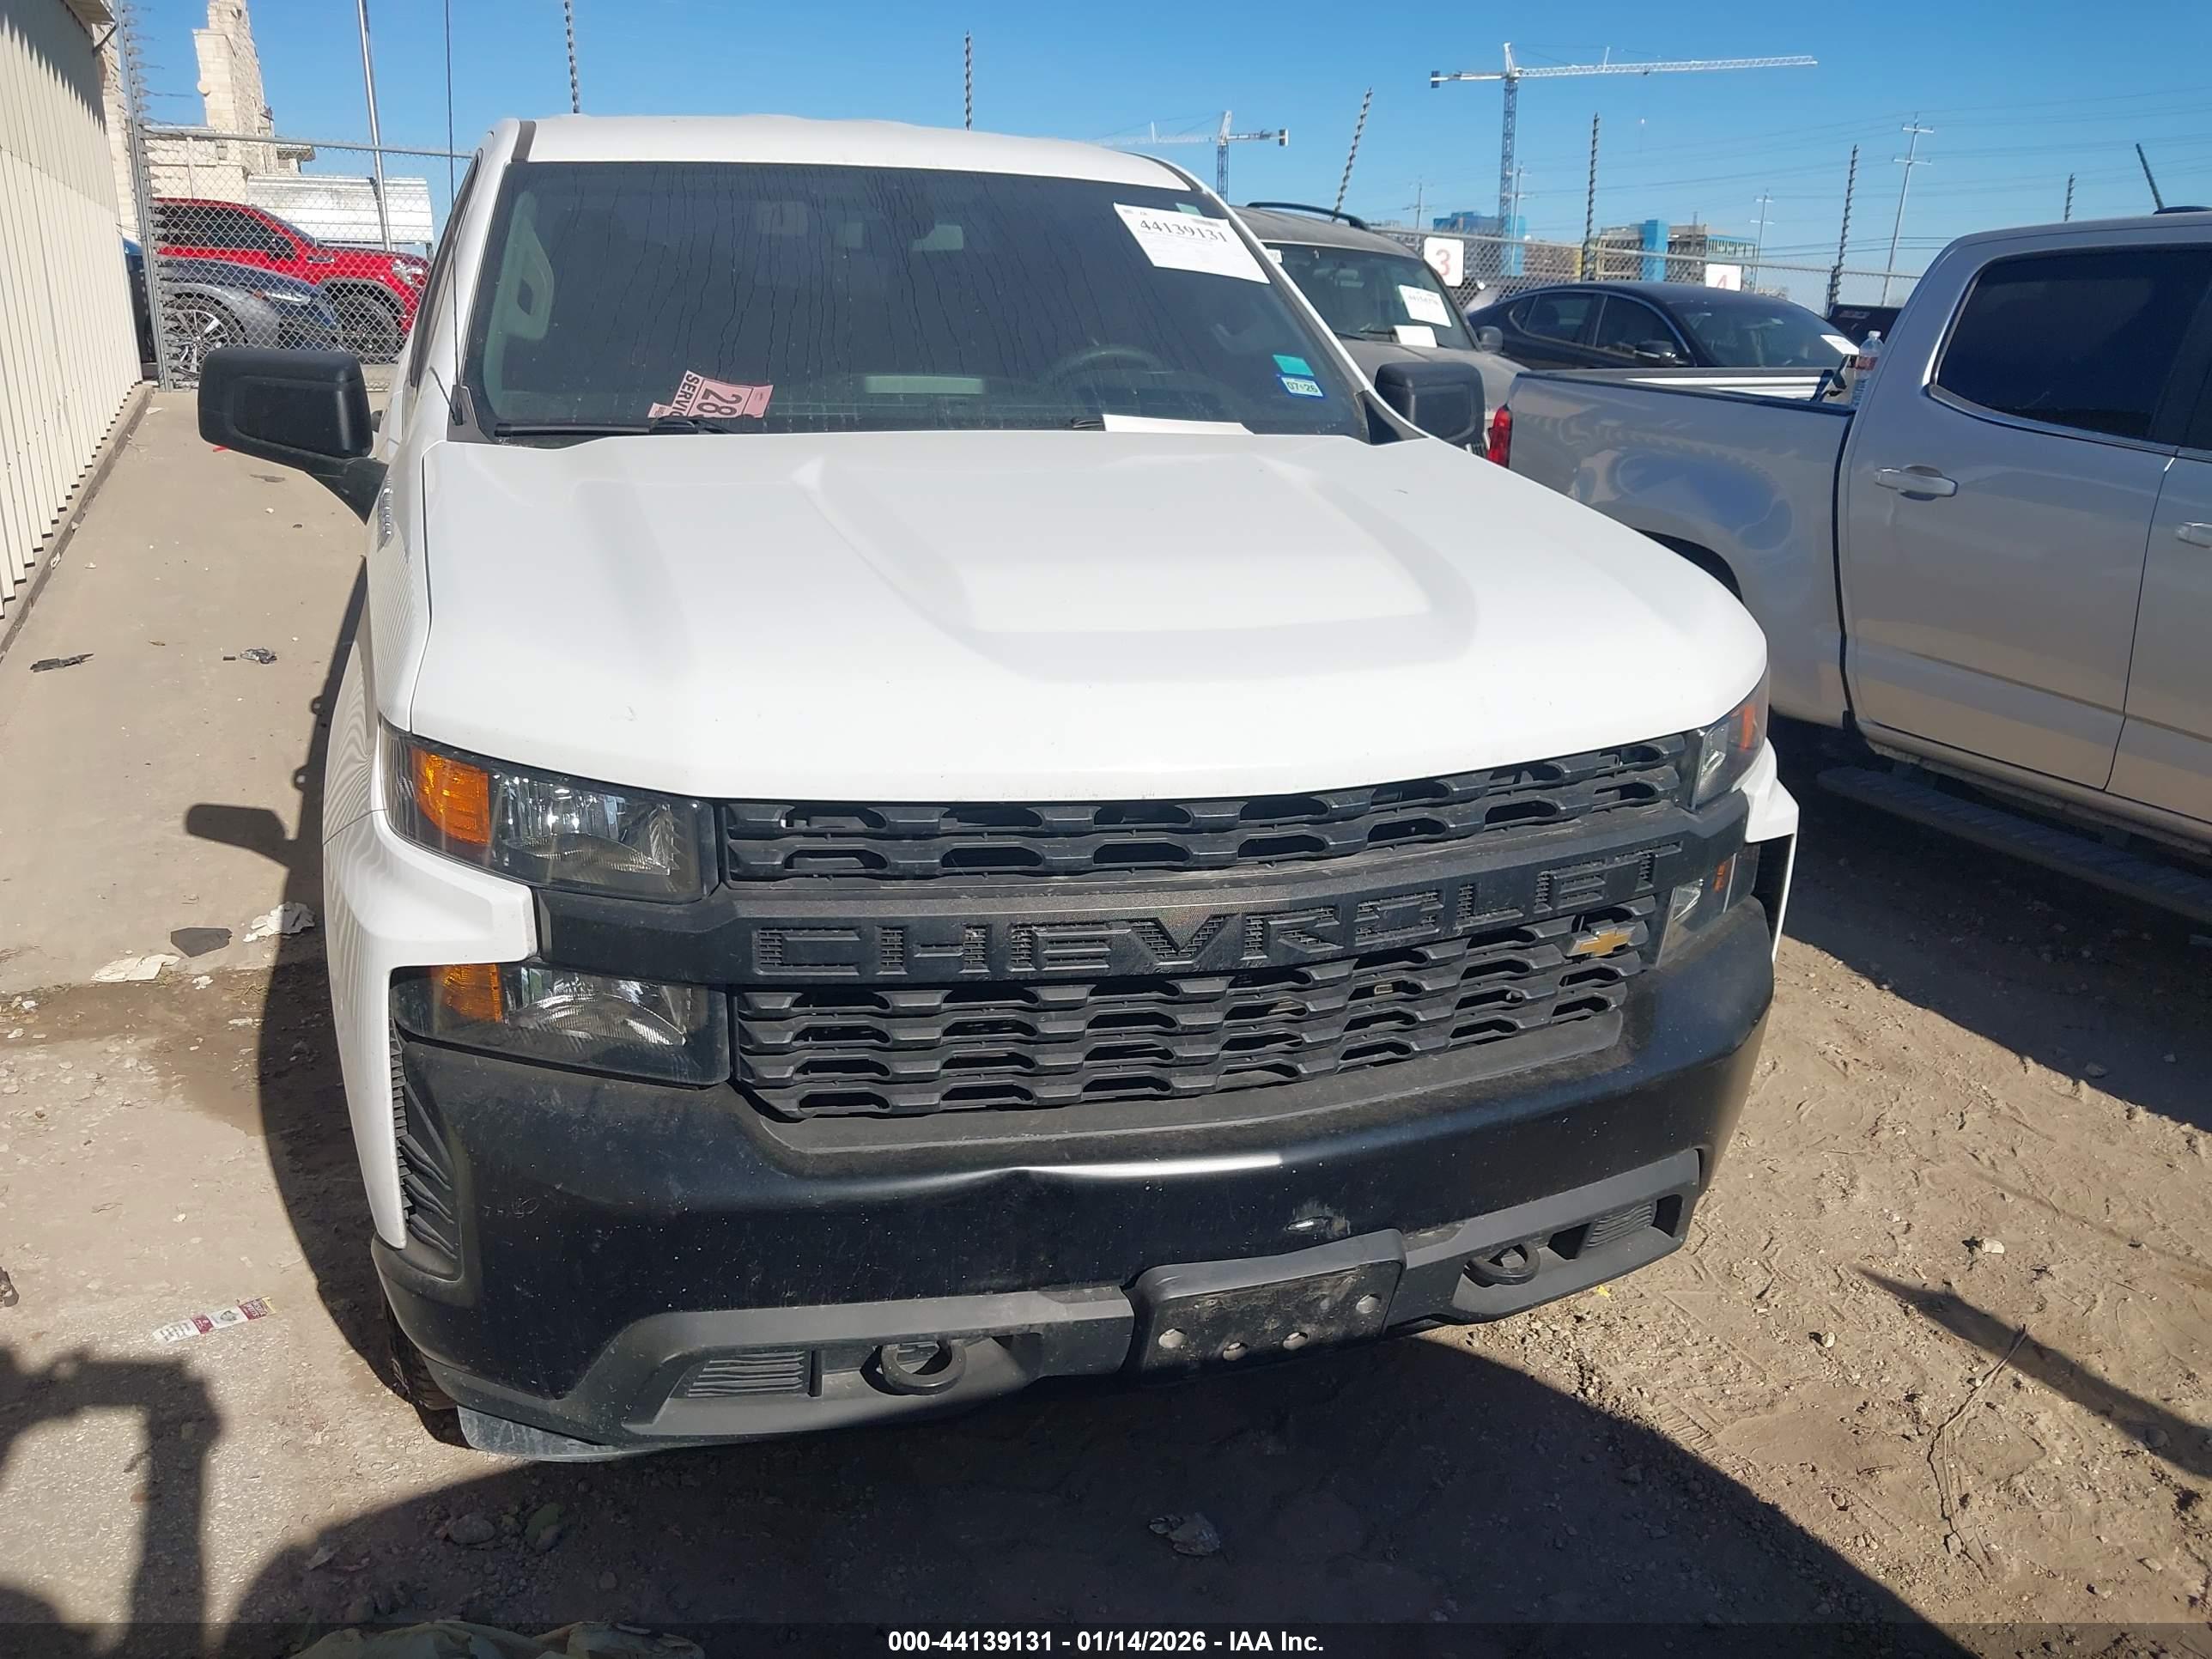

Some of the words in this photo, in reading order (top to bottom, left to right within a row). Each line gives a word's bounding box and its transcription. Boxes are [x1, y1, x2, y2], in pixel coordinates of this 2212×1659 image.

[1139, 220, 1228, 242] 44139131
[1435, 248, 1451, 276] 3
[1286, 381, 1299, 391] 07
[696, 388, 743, 415] 28
[753, 840, 1683, 975] CHEVROLET
